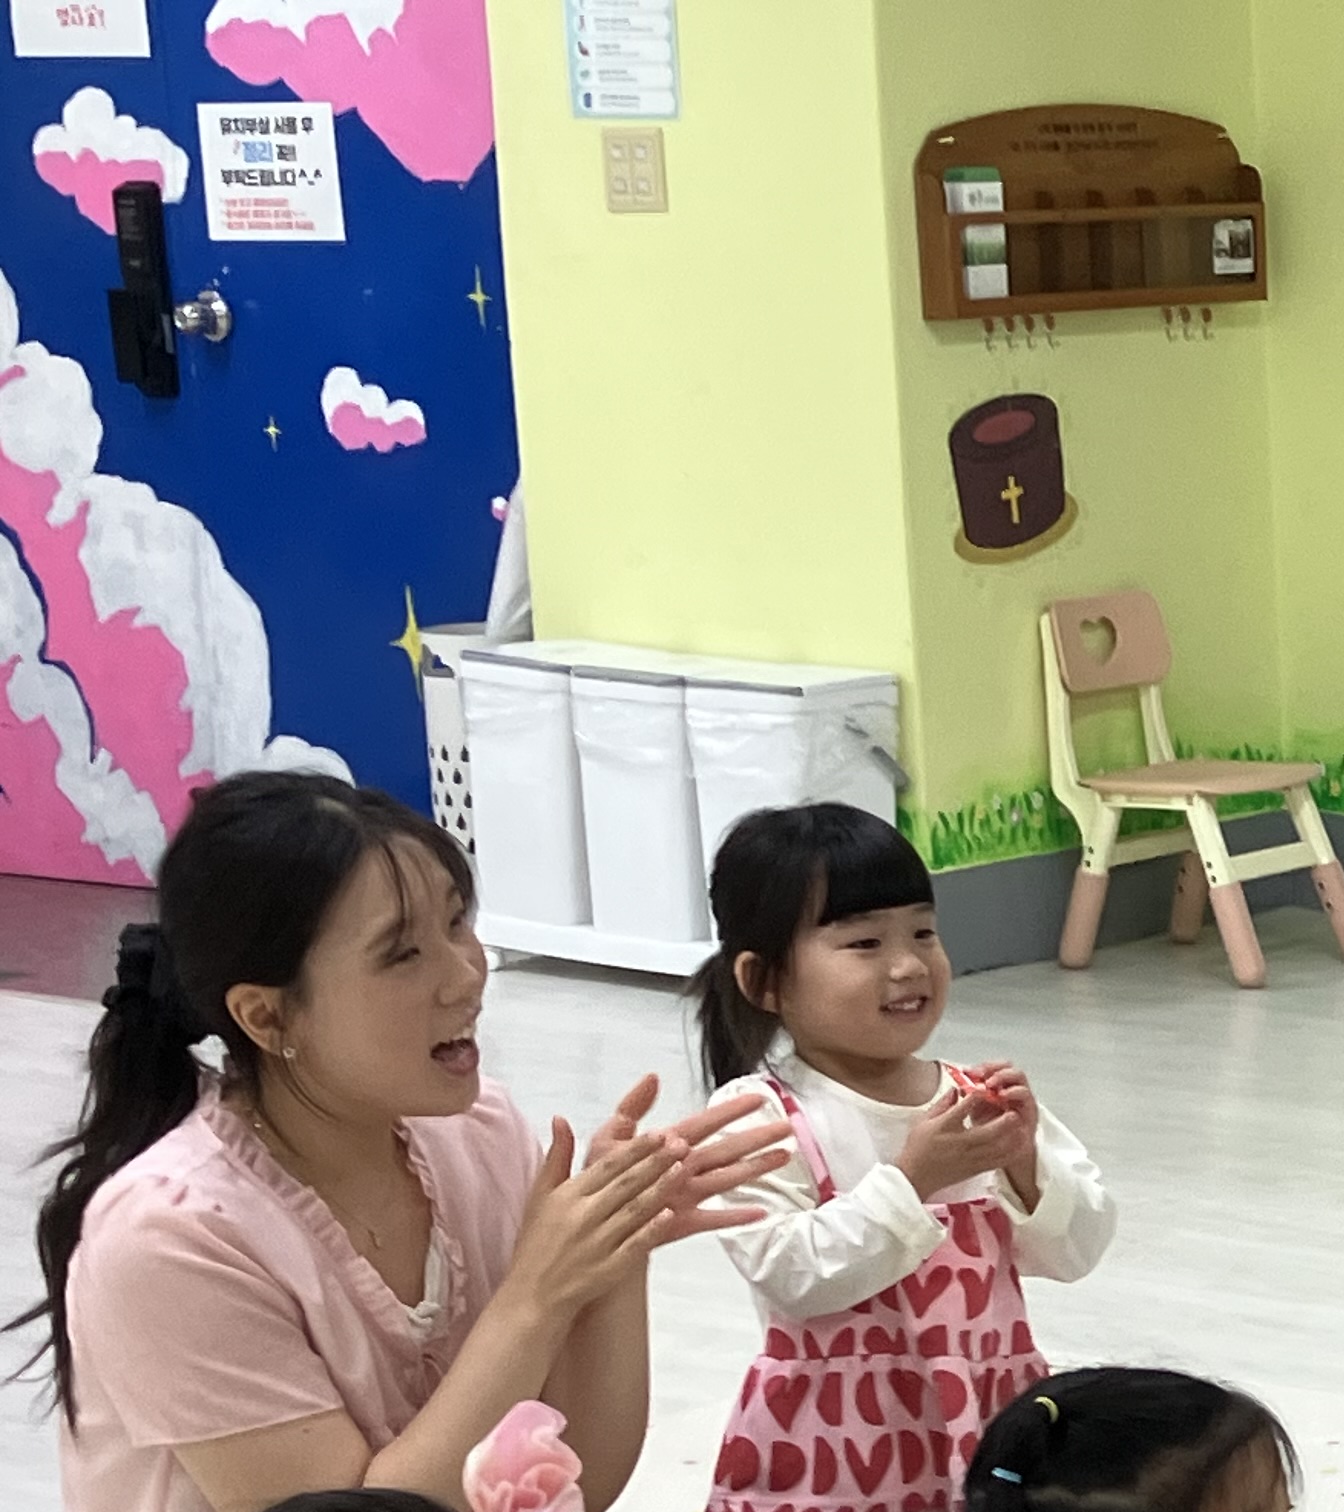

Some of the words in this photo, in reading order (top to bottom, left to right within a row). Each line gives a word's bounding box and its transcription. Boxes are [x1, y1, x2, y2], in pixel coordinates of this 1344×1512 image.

[274, 116, 298, 135] 사용
[301, 117, 314, 135] 후
[221, 168, 296, 187] 부탁드립니다
